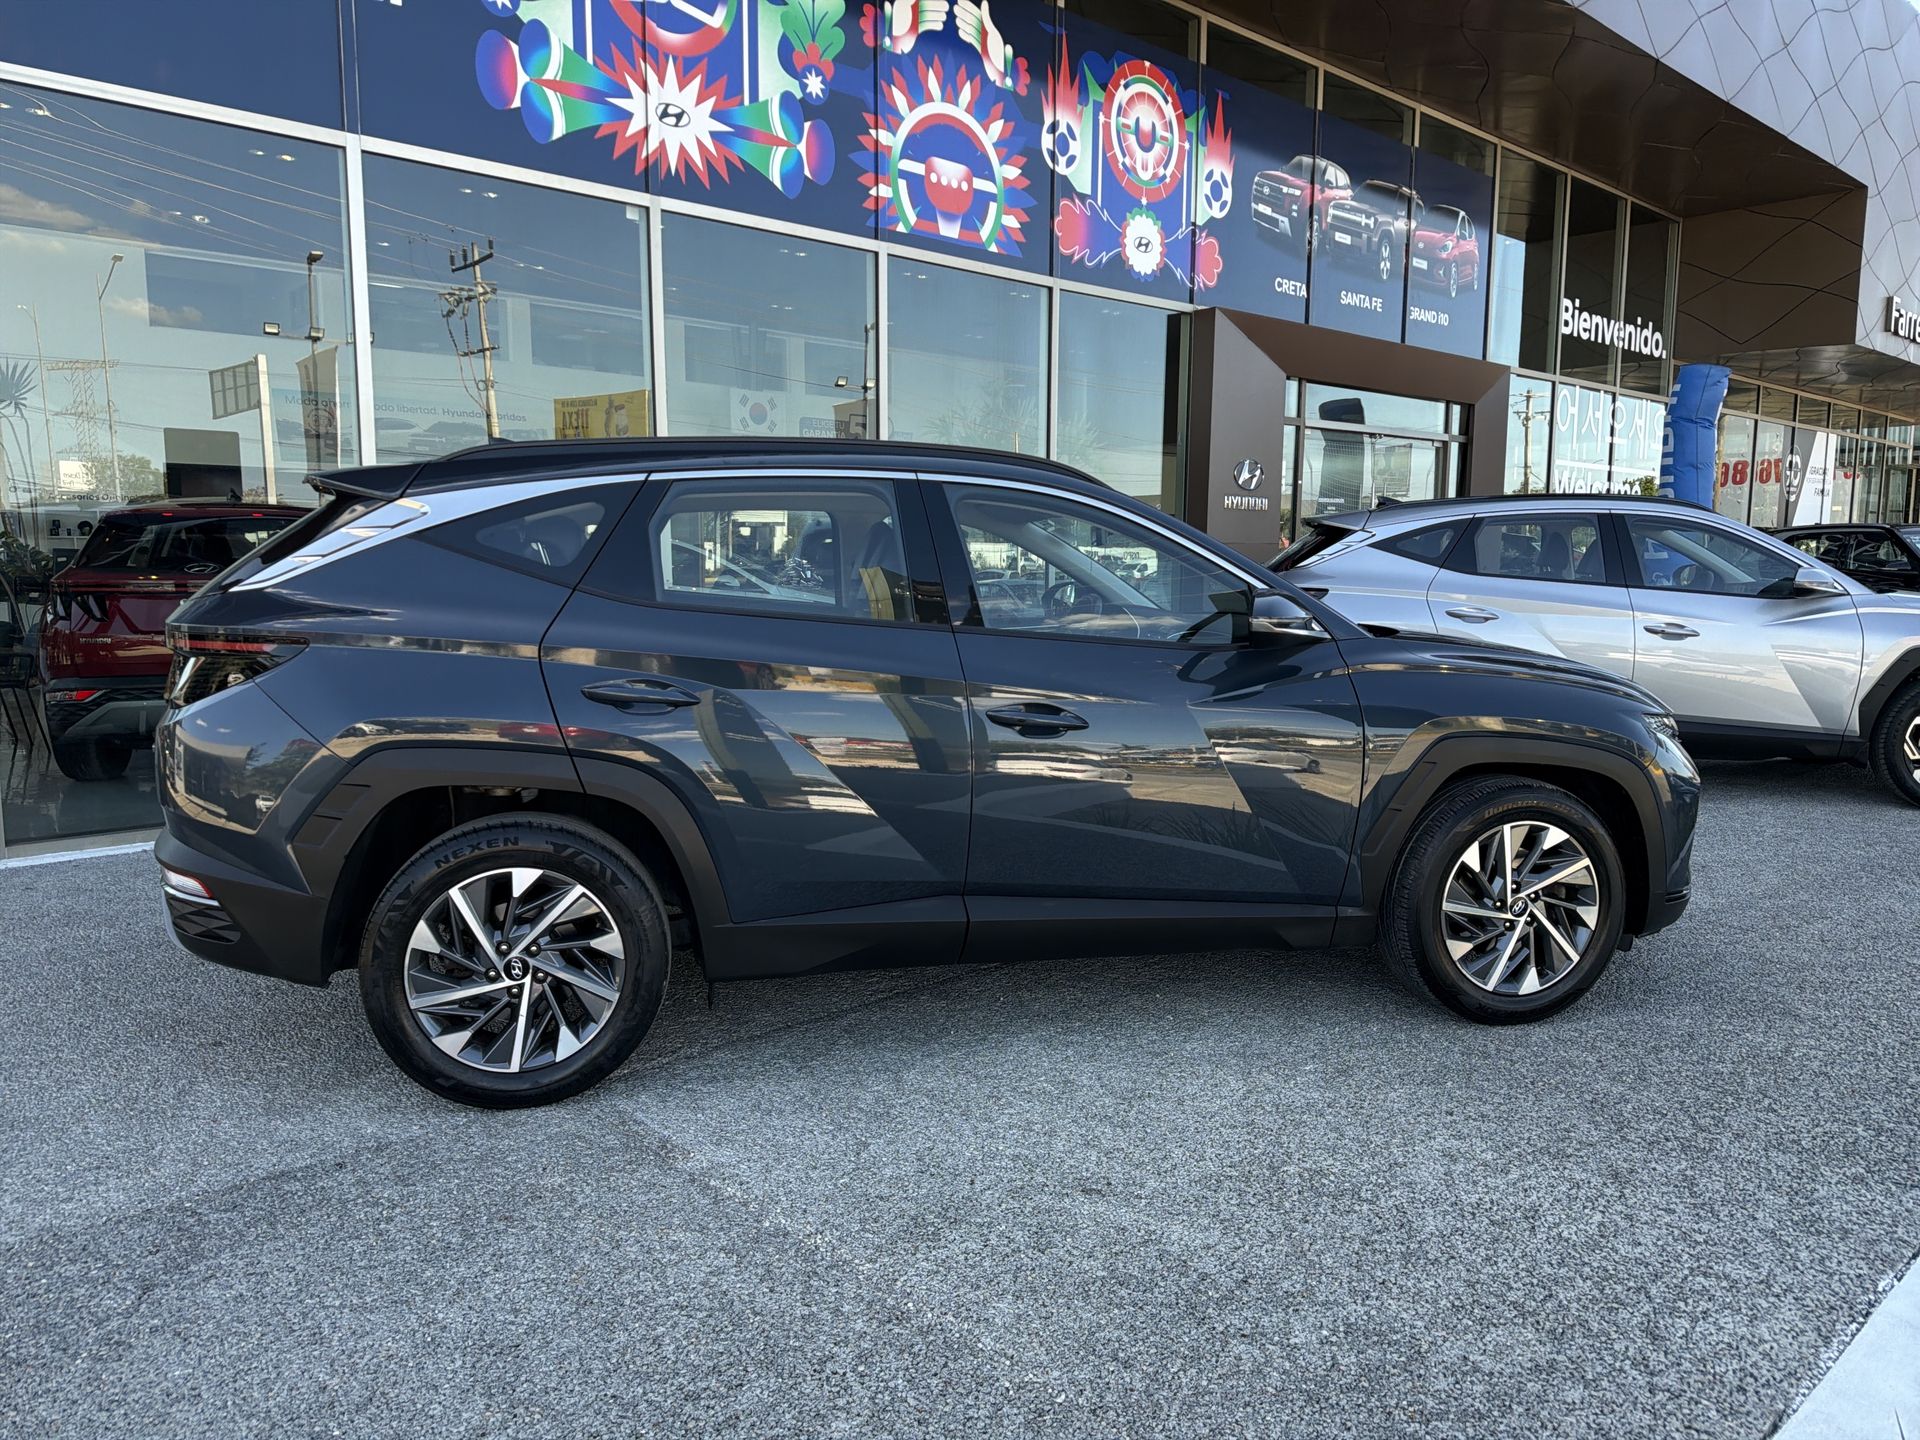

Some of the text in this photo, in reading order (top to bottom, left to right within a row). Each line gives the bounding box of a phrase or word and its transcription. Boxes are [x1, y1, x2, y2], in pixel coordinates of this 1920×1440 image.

[1274, 277, 1307, 299] CRETA
[1340, 290, 1383, 312] SANTA FE
[1410, 306, 1449, 326] GRAND i10
[1561, 297, 1666, 360] Bienvenido.
[374, 402, 395, 412] odo
[1224, 495, 1269, 511] HYUNDAI
[434, 836, 519, 869] NEXEN
